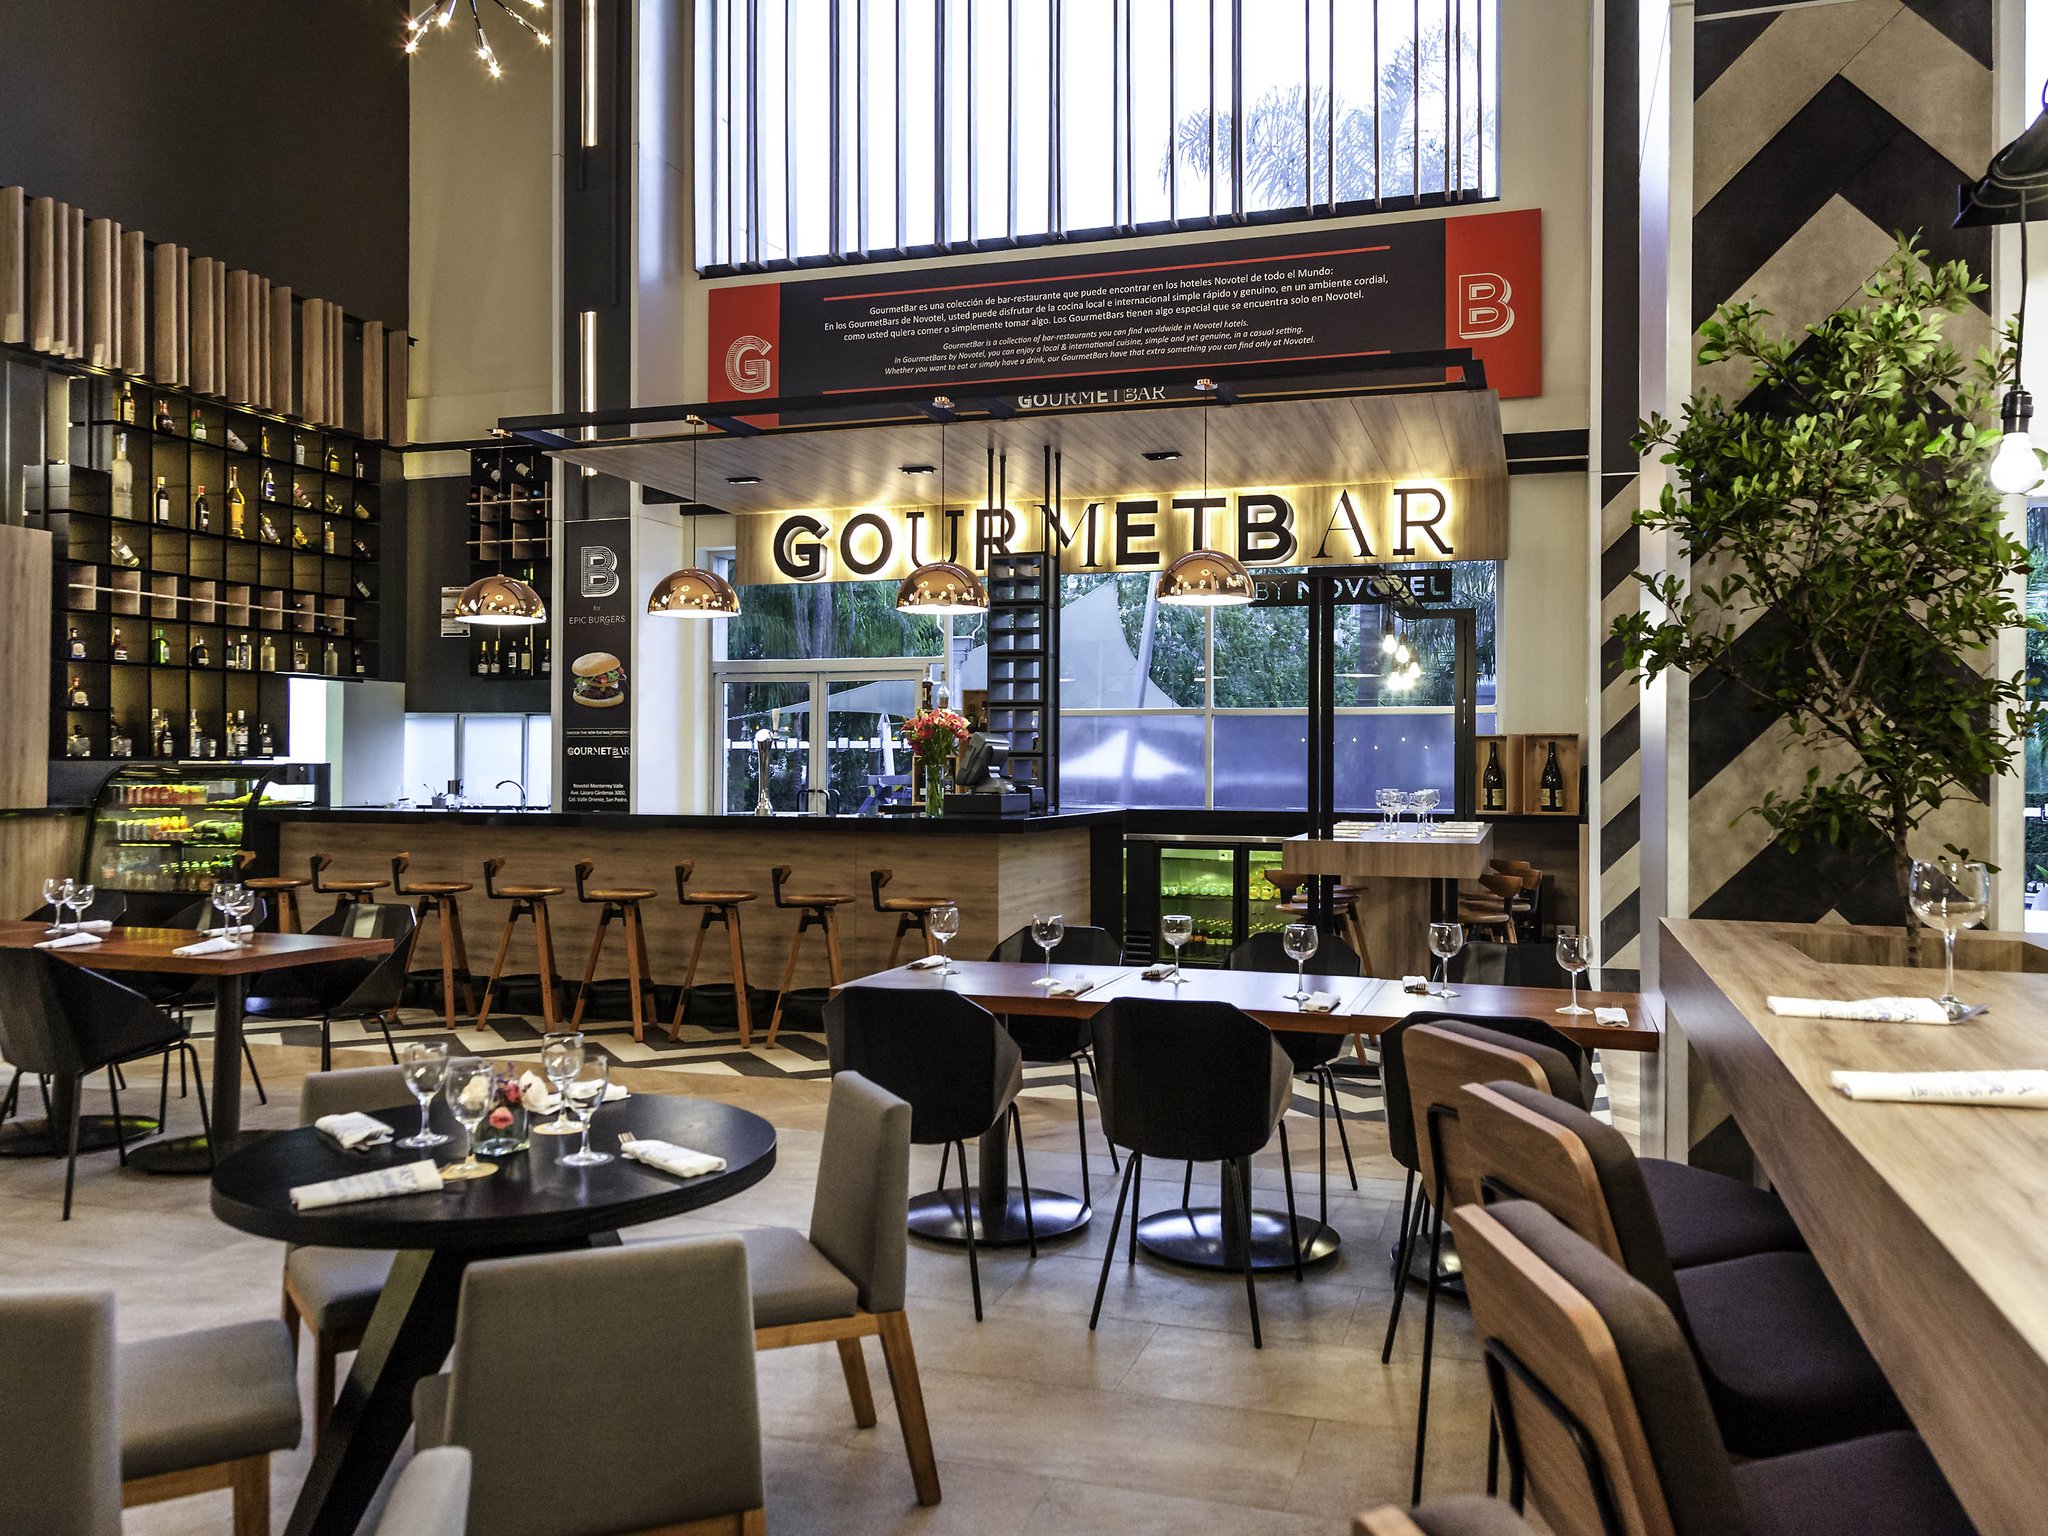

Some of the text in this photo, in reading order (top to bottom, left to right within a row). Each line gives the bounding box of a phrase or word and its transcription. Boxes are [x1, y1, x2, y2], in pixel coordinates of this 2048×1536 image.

[824, 322, 834, 331] En
[835, 321, 847, 330] los
[848, 317, 899, 329] GourmetBars
[900, 316, 911, 324] de
[912, 313, 946, 323] Novotel,
[948, 310, 970, 321] usted
[971, 308, 997, 320] puede
[998, 306, 1034, 316] disfrutar
[1035, 304, 1046, 313] de
[1047, 303, 1055, 312] la
[1056, 301, 1084, 311] cocina
[1085, 298, 1105, 309] local
[1114, 293, 1170, 306] internacional
[1172, 291, 1201, 302] simple
[1202, 288, 1231, 300] rápido
[1232, 290, 1238, 298] y
[1239, 285, 1279, 298] genuino,
[1280, 284, 1292, 292] en
[1294, 283, 1306, 291] un
[1308, 279, 1352, 290] ambiente
[1354, 273, 1388, 286] cordial,
[843, 333, 866, 341] como
[866, 329, 889, 339] usted
[890, 328, 915, 339] quiera
[916, 327, 943, 335] comer
[951, 321, 1003, 333] simplemente
[1004, 319, 1030, 328] tomar
[1031, 316, 1051, 327] algo.
[1053, 315, 1067, 324] Los
[1068, 311, 1124, 323] GourmetBars
[1126, 309, 1153, 318] tienen
[1155, 306, 1174, 317] algo
[1175, 302, 1210, 315] especial
[1212, 303, 1229, 313] que
[1231, 302, 1241, 310] se
[1243, 298, 1288, 309] encuentra
[1290, 294, 1309, 305] solo
[1311, 295, 1323, 303] en
[1325, 289, 1364, 301] Novotel.
[869, 266, 1333, 315] GourmetBar es una colección de bar-restaurante que puede encontrar en los hoteles Novotel de todo el Mundo:
[1459, 272, 1515, 340] B
[884, 366, 914, 375] Whether
[914, 366, 928, 374] you
[929, 364, 947, 372] want
[956, 362, 968, 370] eat
[978, 359, 1001, 368] simply
[1001, 358, 1019, 366] have
[1061, 351, 1108, 361] GourmetBars
[1109, 350, 1128, 358] have
[1129, 348, 1145, 356] that
[1145, 347, 1165, 355] extra
[1166, 344, 1206, 354] something
[1207, 344, 1222, 352] you
[1237, 340, 1254, 351] find
[1254, 339, 1272, 348] only
[1282, 335, 1315, 345] Novotel.
[902, 353, 947, 363] GourmetBars
[948, 352, 957, 361] by
[958, 350, 986, 359] Novotel,
[987, 350, 1001, 358] you
[1001, 348, 1014, 356] can
[1015, 346, 1035, 355] enjoy
[1042, 343, 1060, 352] local
[1068, 339, 1115, 350] international
[1144, 335, 1169, 345] simple
[1170, 334, 1185, 342] and
[1186, 334, 1198, 343] yet
[1233, 330, 1241, 338] in
[1249, 327, 1274, 337] casual
[942, 340, 985, 350] GourmetBar
[998, 336, 1032, 345] collection
[1032, 334, 1042, 344] of
[1041, 331, 1097, 341] bar-restaurants
[1098, 330, 1112, 339] you
[1126, 326, 1143, 336] find
[1143, 323, 1183, 333] worldwide
[1192, 320, 1223, 330] Novotel
[725, 335, 773, 394] G
[773, 488, 1454, 582] GOURMETBAR
[581, 545, 619, 598] B
[1255, 576, 1445, 601] BY NVEL
[568, 614, 626, 626] EPIC BURGERS
[567, 746, 630, 756] GOURMETBAR
